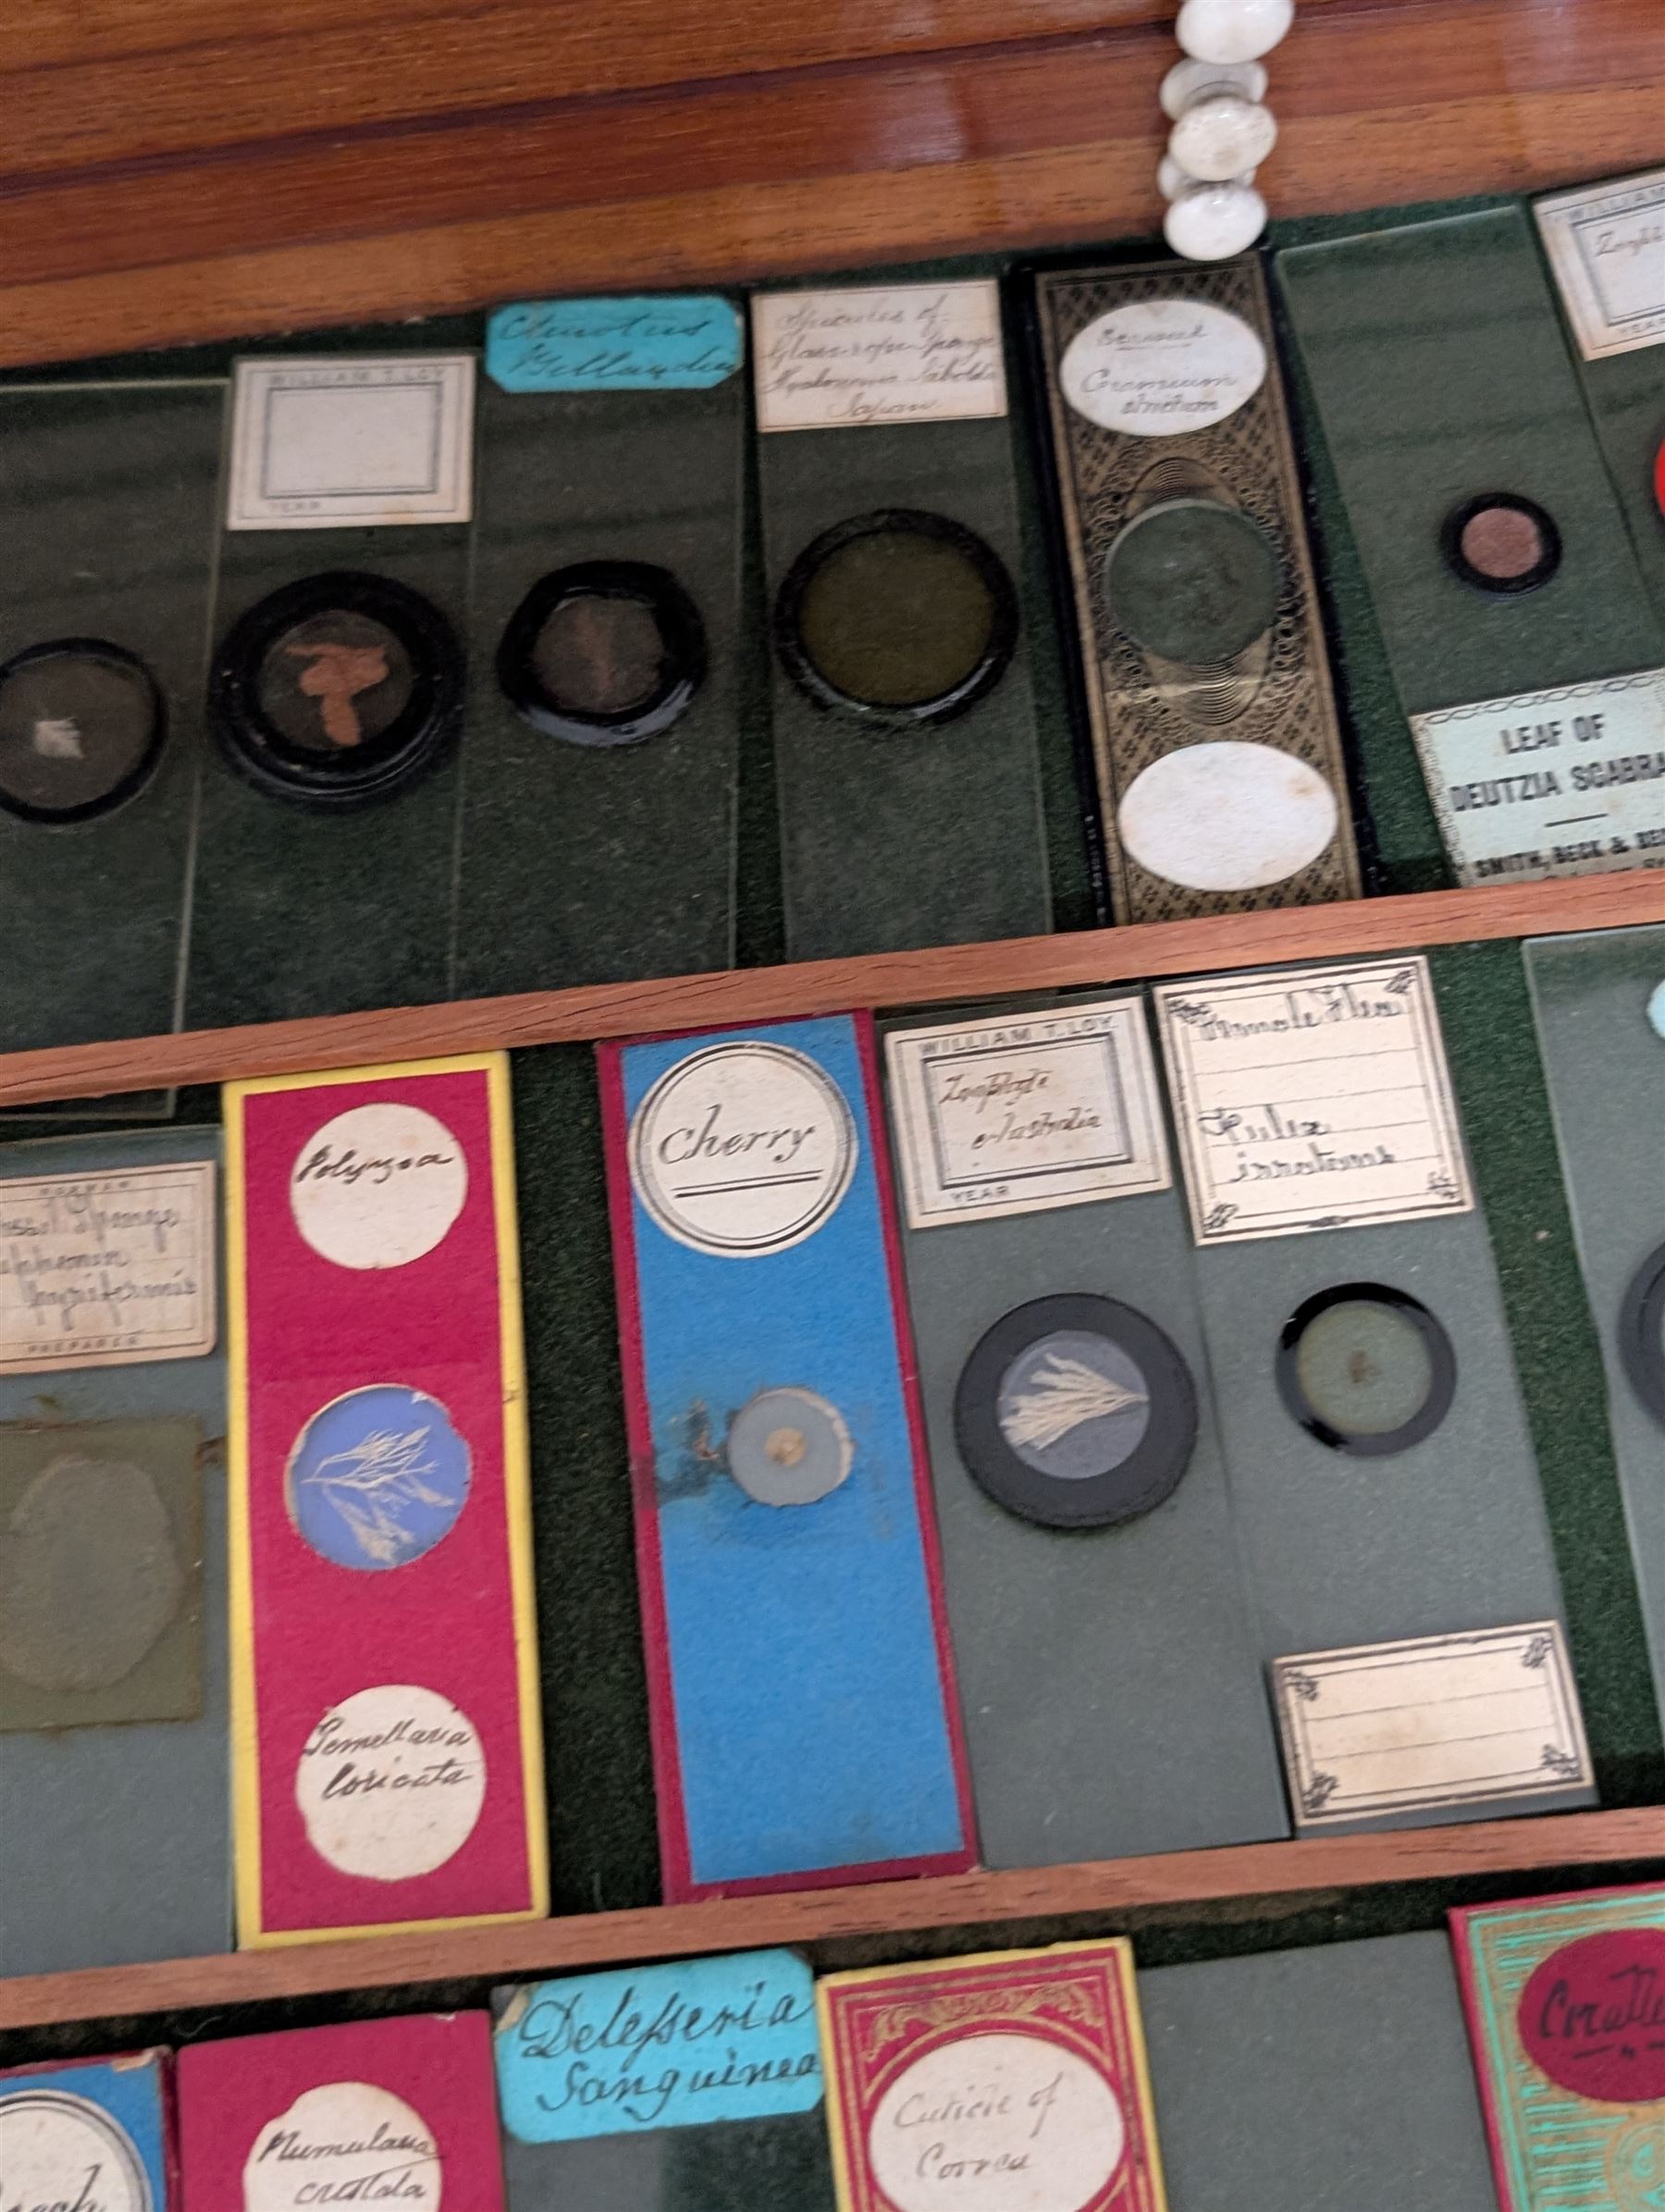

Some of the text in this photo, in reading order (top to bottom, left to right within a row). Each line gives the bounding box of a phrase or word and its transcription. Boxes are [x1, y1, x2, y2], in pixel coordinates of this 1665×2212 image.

[1499, 712, 1605, 755] LEAF OF
[1449, 771, 1562, 811] DEUTZIA
[919, 1028, 1032, 1055] WILLIAM
[658, 1104, 816, 1165] Cherry
[950, 1184, 1010, 1203] YEAR
[1030, 2070, 1064, 2140] of
